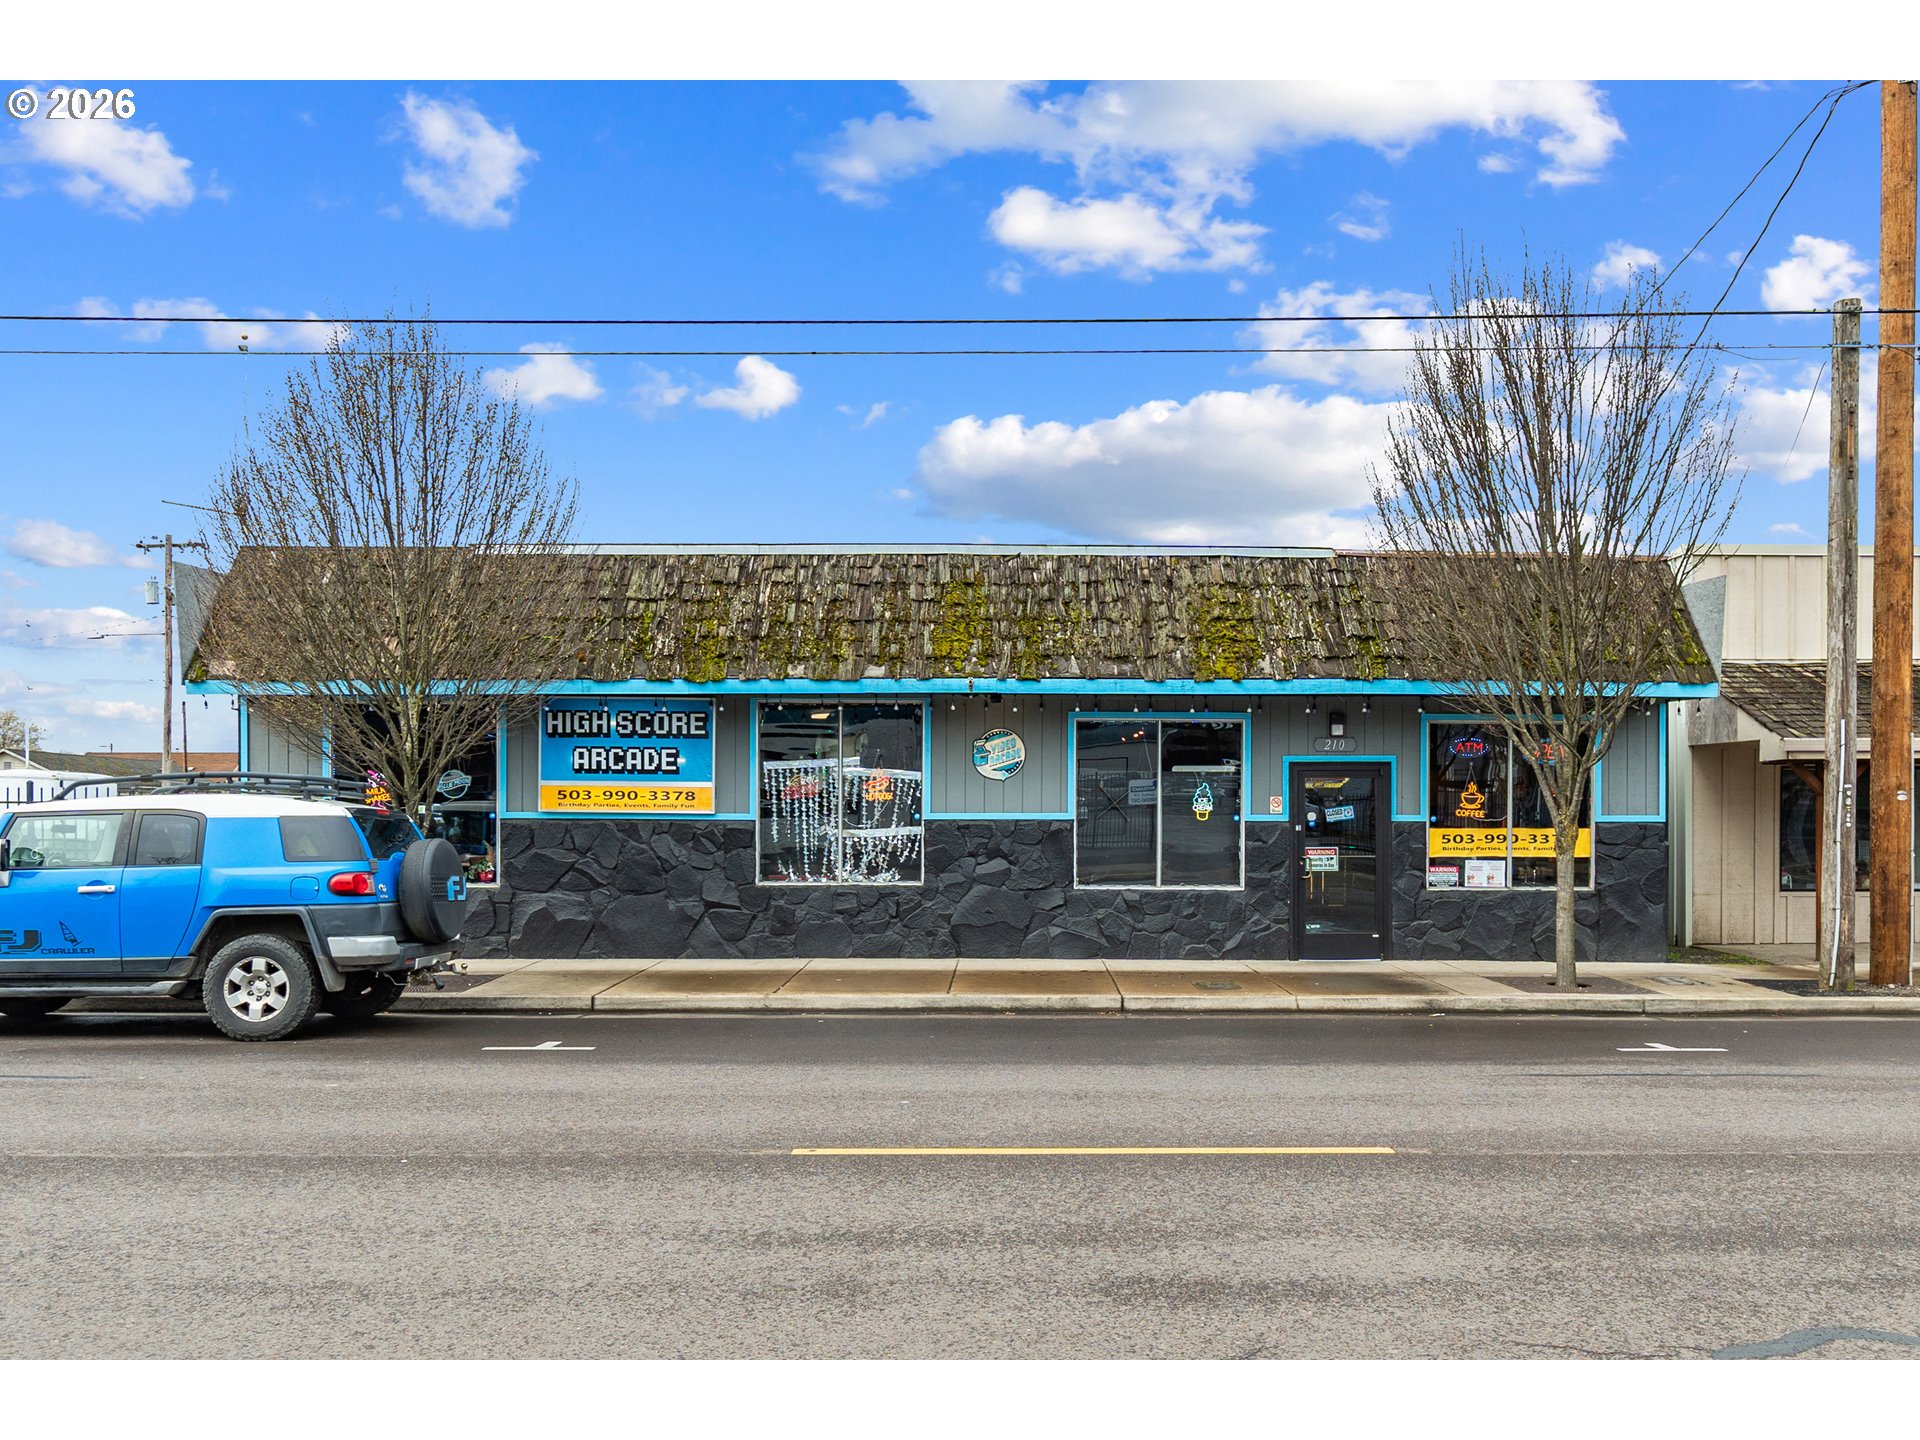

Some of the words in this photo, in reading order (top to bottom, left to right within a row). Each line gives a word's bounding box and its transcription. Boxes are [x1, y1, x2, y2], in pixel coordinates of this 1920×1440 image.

[546, 711, 610, 736] HIGH
[616, 712, 708, 737] SCORE
[1324, 739, 1345, 750] 210
[1456, 742, 1485, 753] ATM
[573, 747, 679, 773] ARCADE
[557, 789, 696, 801] 503-990-3378
[1326, 808, 1343, 817] CLOSED
[1456, 809, 1485, 818] COFFEE
[1441, 833, 1557, 844] 503-990-33
[447, 876, 466, 900] FJ
